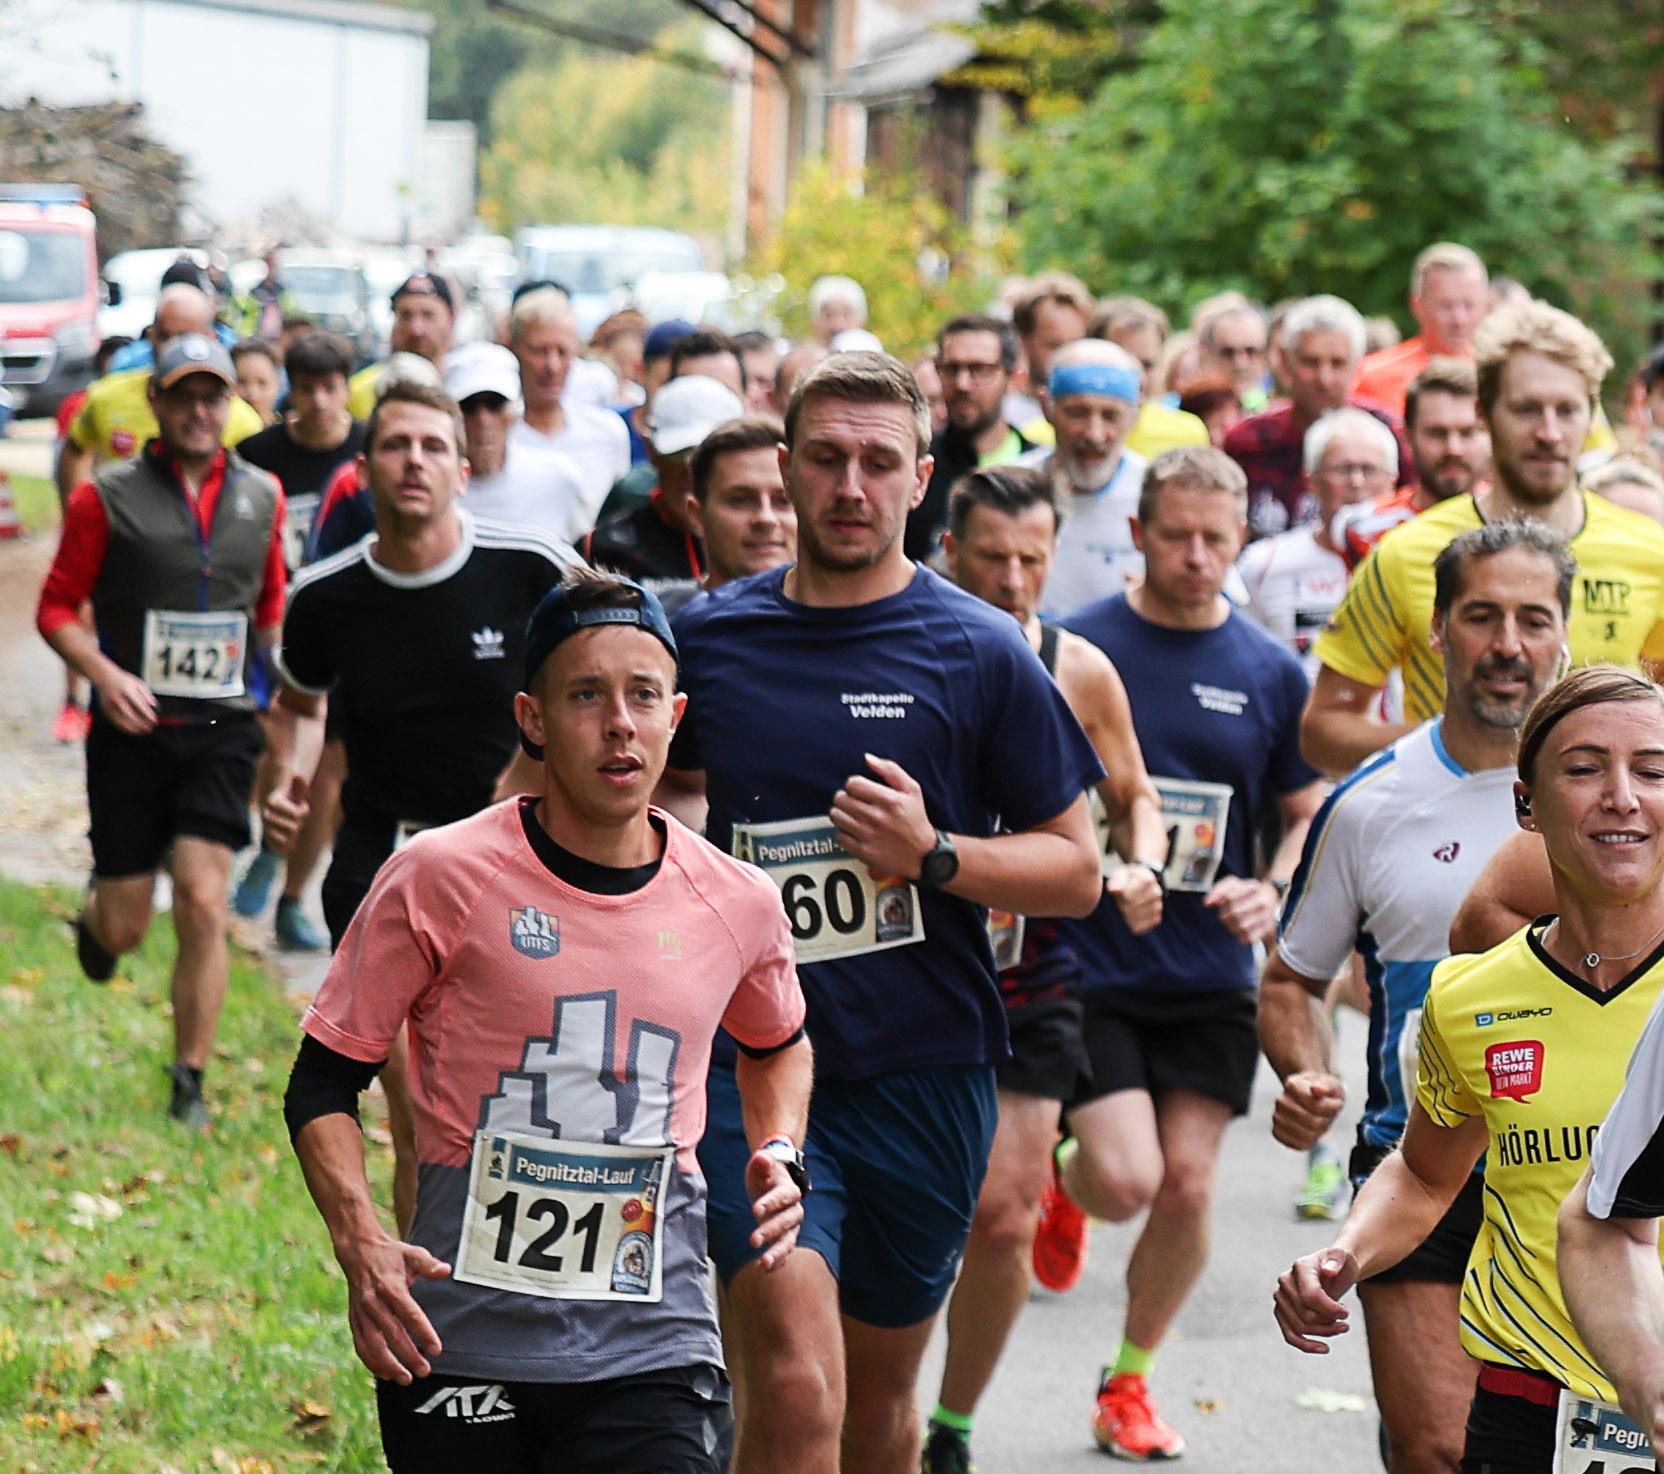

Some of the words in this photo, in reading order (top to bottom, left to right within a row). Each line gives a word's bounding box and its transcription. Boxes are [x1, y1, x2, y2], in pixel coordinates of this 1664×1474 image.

[158, 647, 219, 679] 142
[850, 705, 905, 719] Velden
[759, 836, 846, 862] Pegnitztal-
[1492, 1047, 1535, 1066] REWE
[516, 1156, 636, 1185] Pegnitztal-Lauf
[485, 1190, 605, 1273] 121
[1603, 1423, 1650, 1449] Pegn
